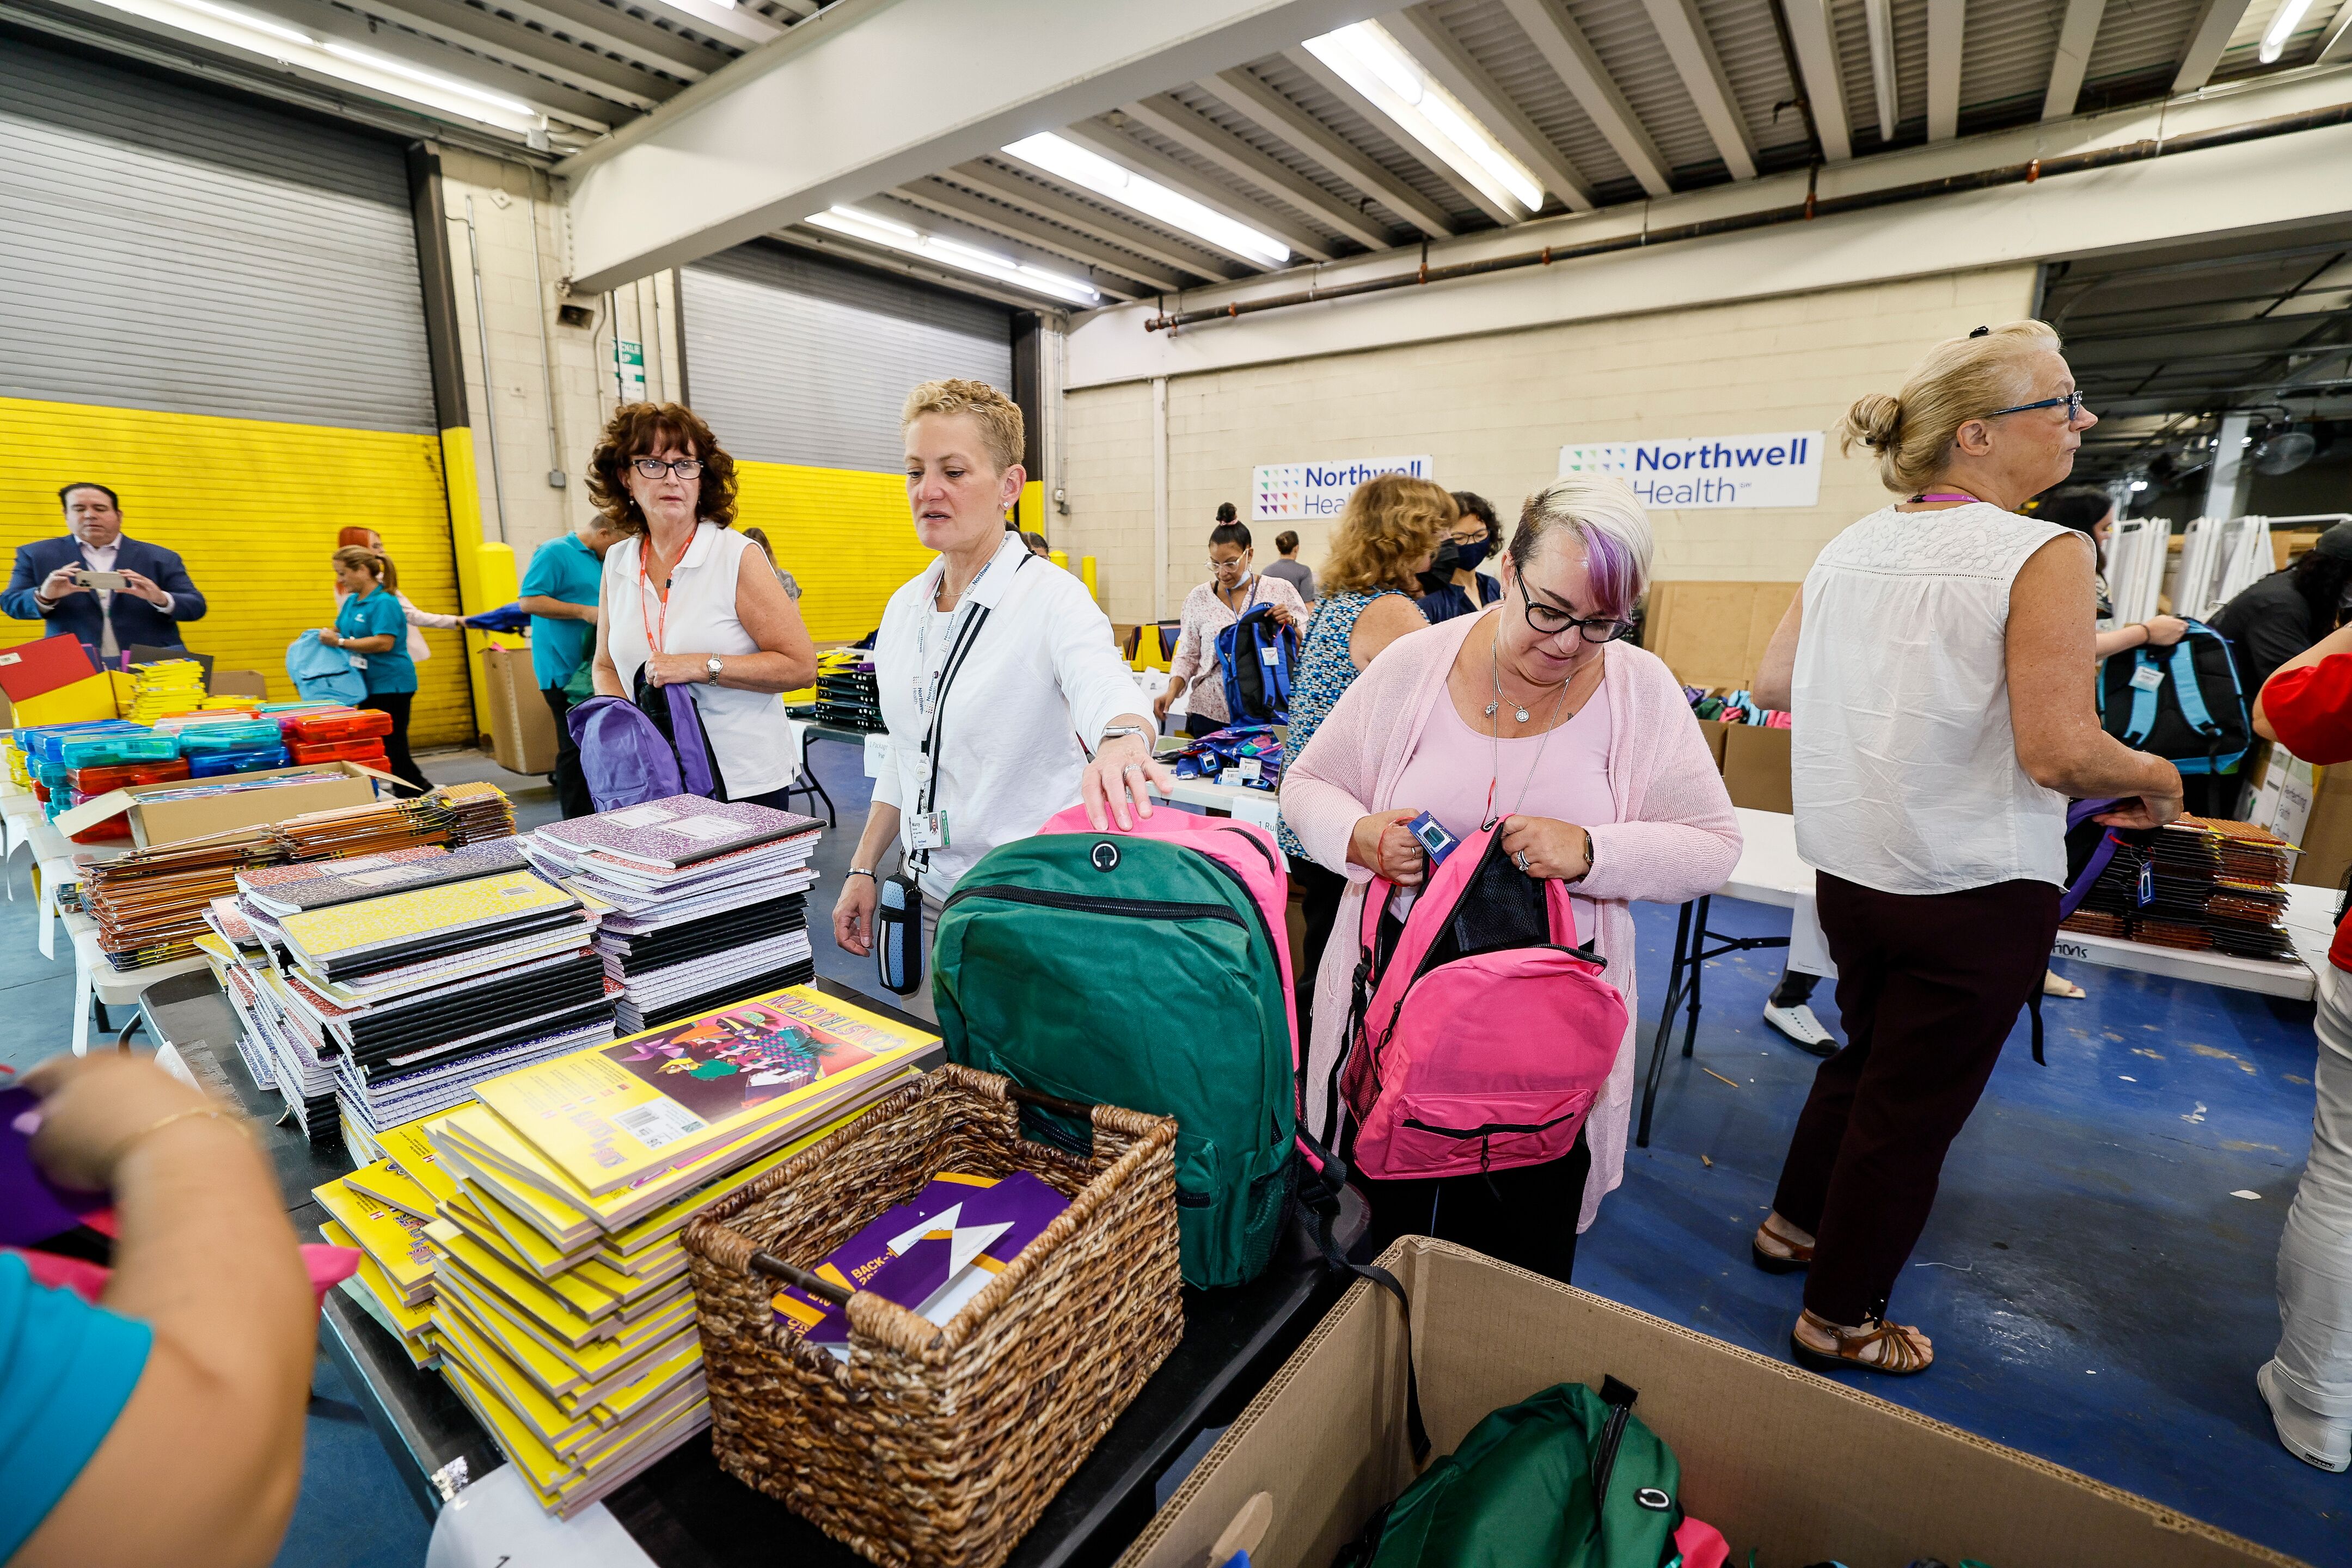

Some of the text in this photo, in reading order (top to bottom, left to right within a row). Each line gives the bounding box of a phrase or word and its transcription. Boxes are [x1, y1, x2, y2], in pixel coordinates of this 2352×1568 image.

[1635, 438, 1807, 471] Northwell
[1633, 476, 1735, 504] Health
[972, 561, 992, 585] Northwell
[944, 614, 955, 641] Northwell
[761, 993, 906, 1054] CONSTRUCTION
